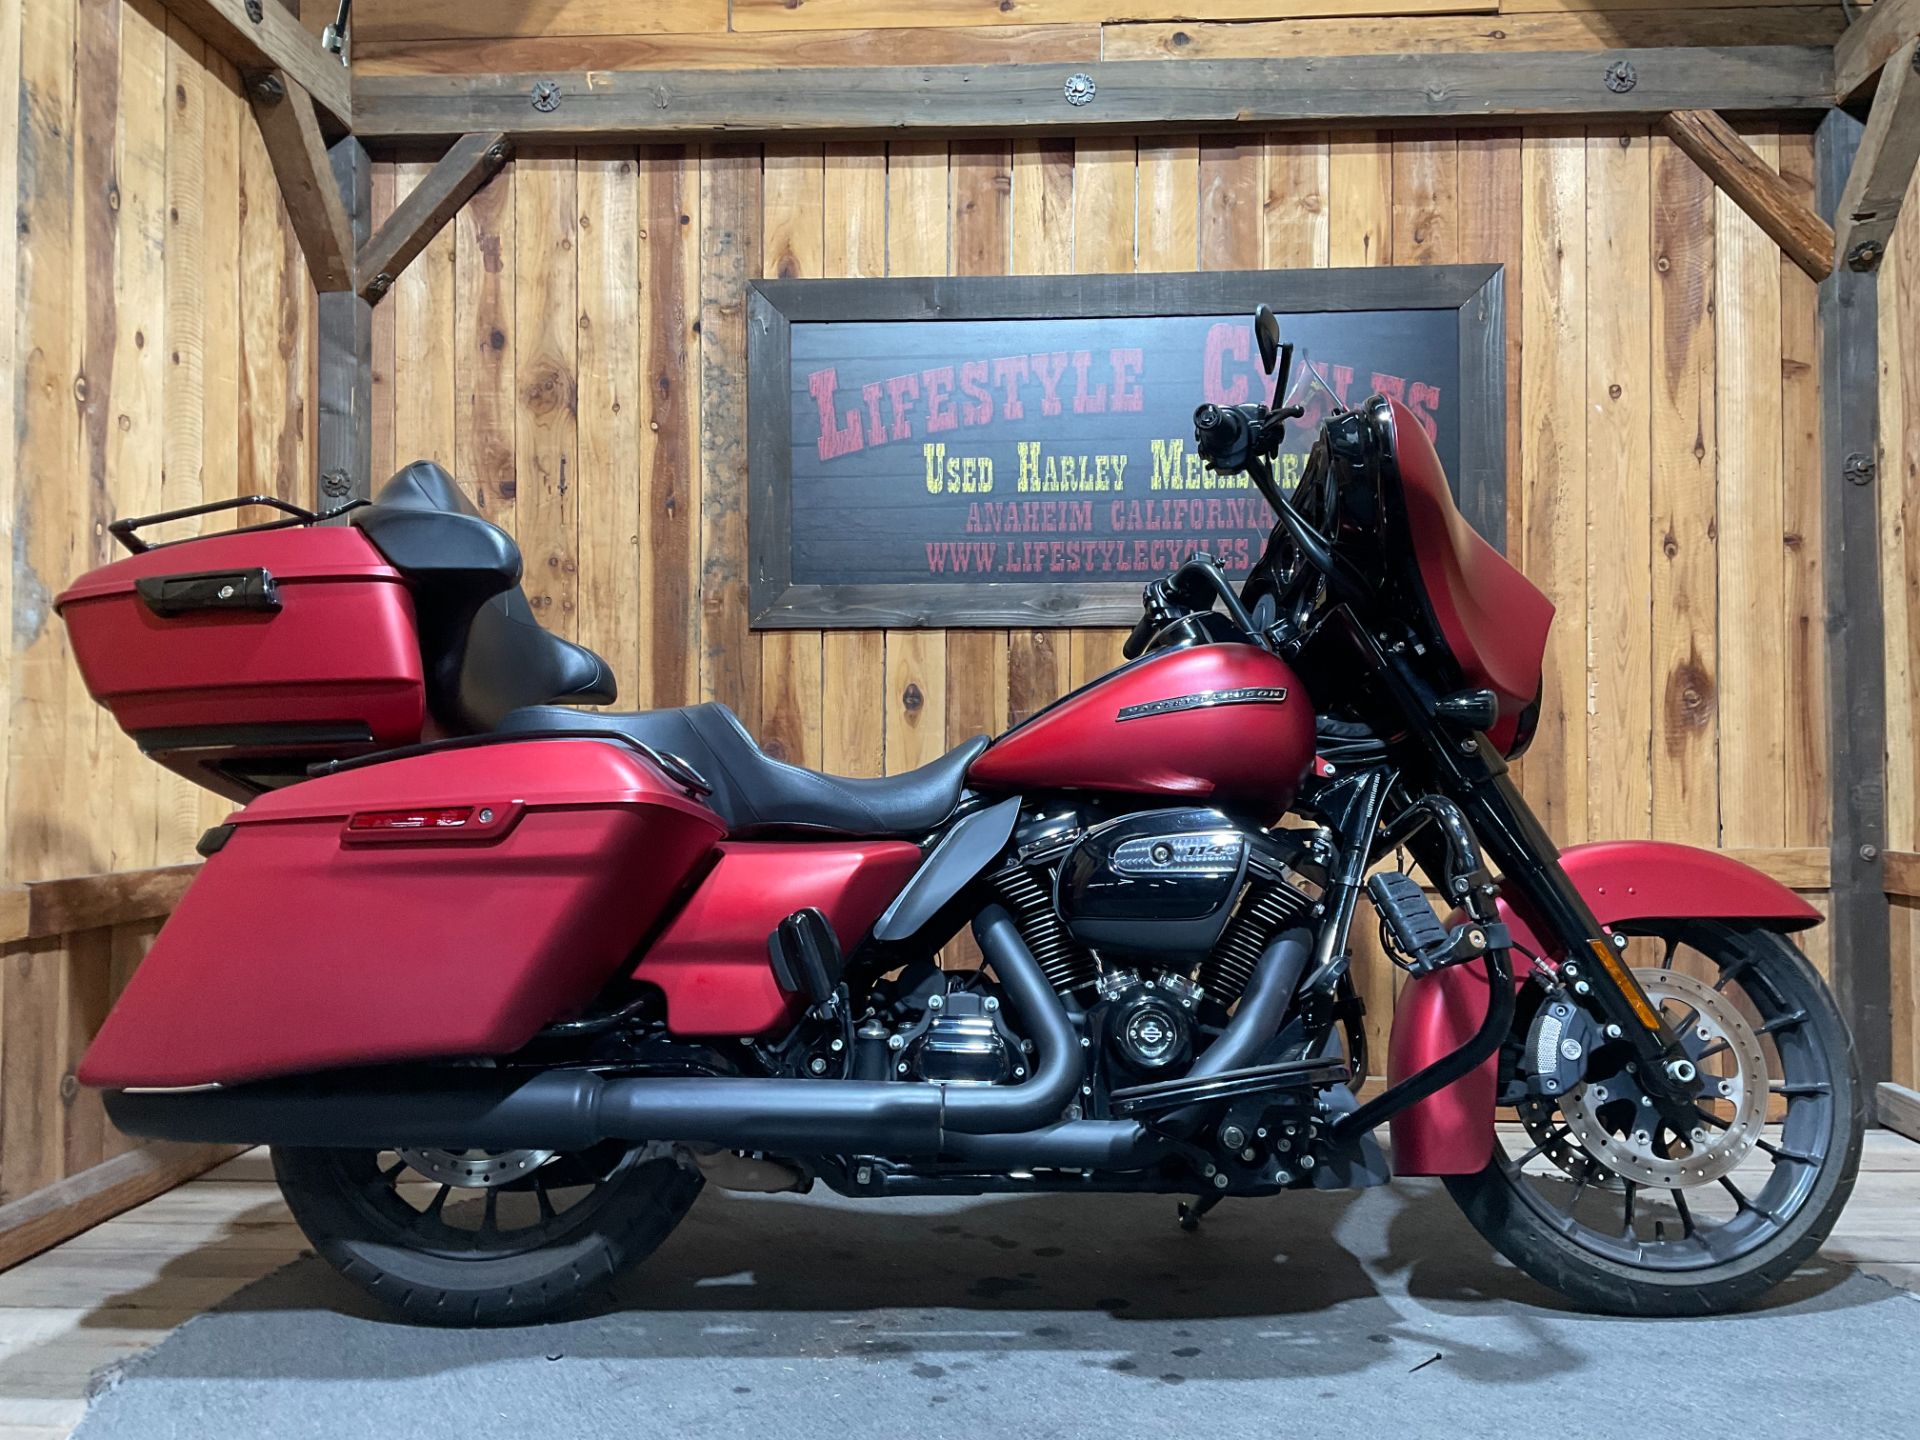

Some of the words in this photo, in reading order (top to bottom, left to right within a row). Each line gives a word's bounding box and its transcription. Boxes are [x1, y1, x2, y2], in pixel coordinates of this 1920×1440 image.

[923, 443, 994, 494] USED
[1017, 441, 1128, 492] HARLEY
[965, 501, 1093, 533] ANAHEIM
[1111, 498, 1274, 532] CALIFORNIA
